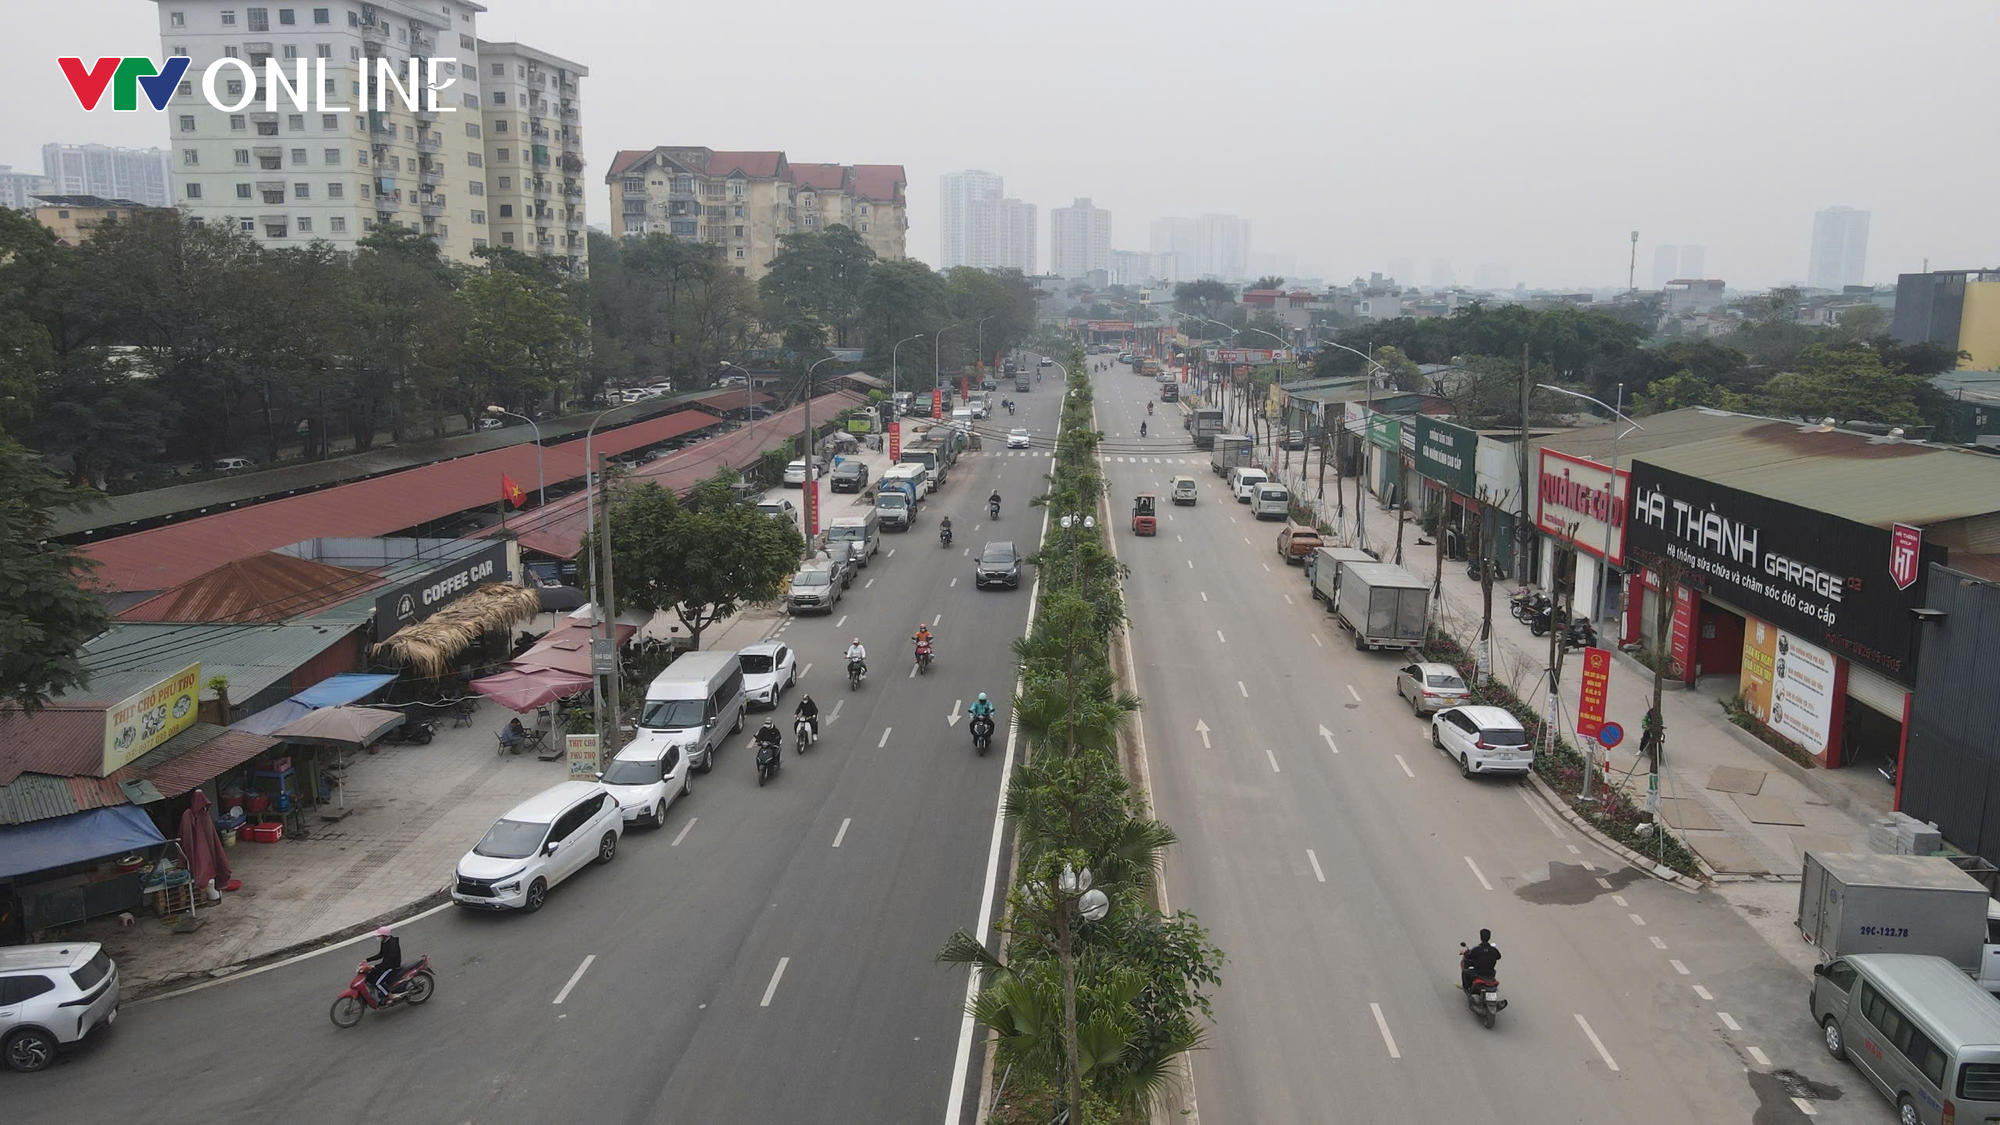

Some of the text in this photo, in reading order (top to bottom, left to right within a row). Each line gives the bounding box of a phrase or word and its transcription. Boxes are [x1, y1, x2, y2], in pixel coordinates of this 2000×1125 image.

[1541, 468, 1590, 515] QUẢNG
[1635, 483, 1760, 568] HÀ THÀNH
[422, 560, 494, 606] COFFEE CAR
[1666, 542, 1676, 558] Hệ
[1676, 546, 1696, 569] thống
[1711, 562, 1730, 580] chữa
[1731, 571, 1741, 585] và
[1741, 574, 1763, 594] chăm
[1764, 585, 1780, 601] sóc
[1781, 589, 1796, 608] ôtô
[1798, 600, 1816, 616] cao
[1817, 603, 1836, 627] cấp
[1764, 552, 1844, 603] GARAGE
[1894, 546, 1914, 582] HT
[113, 704, 136, 726] THỊT
[178, 673, 195, 693] THỌ
[1860, 925, 1909, 938] 29C-122.78
